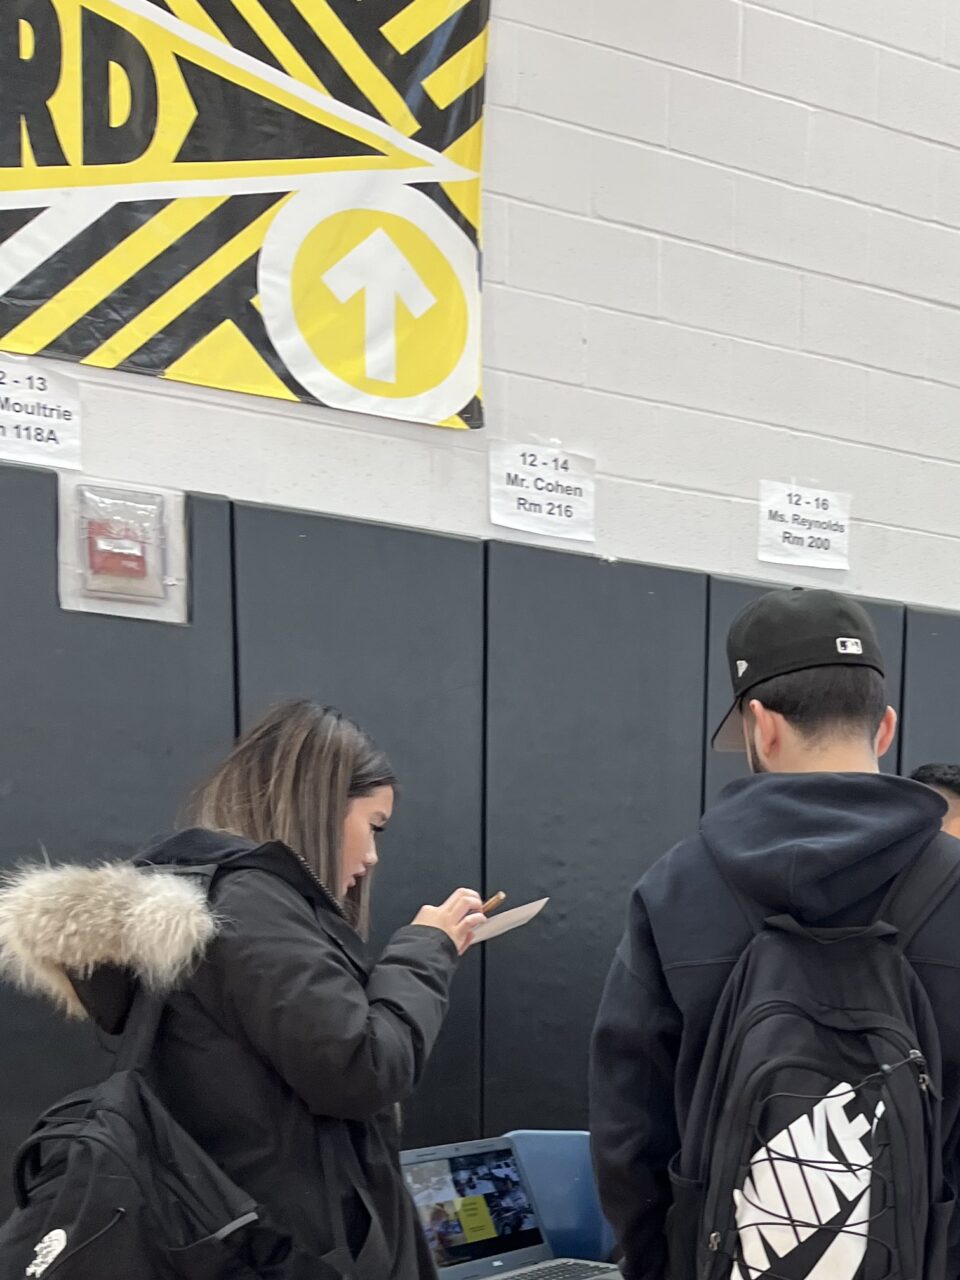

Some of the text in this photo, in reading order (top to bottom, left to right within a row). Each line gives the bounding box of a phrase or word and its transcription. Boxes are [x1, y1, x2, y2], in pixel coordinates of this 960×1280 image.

[25, 375, 48, 392] 13
[13, 424, 60, 445] 118A
[520, 452, 538, 468] 12
[552, 457, 570, 473] 14
[505, 472, 583, 498] Mr. Cohen
[516, 497, 574, 518] Rm 216
[786, 492, 802, 507] 12
[814, 497, 830, 511] 16
[768, 509, 845, 533] Ms. Reynolds
[782, 531, 831, 551] Rm 200
